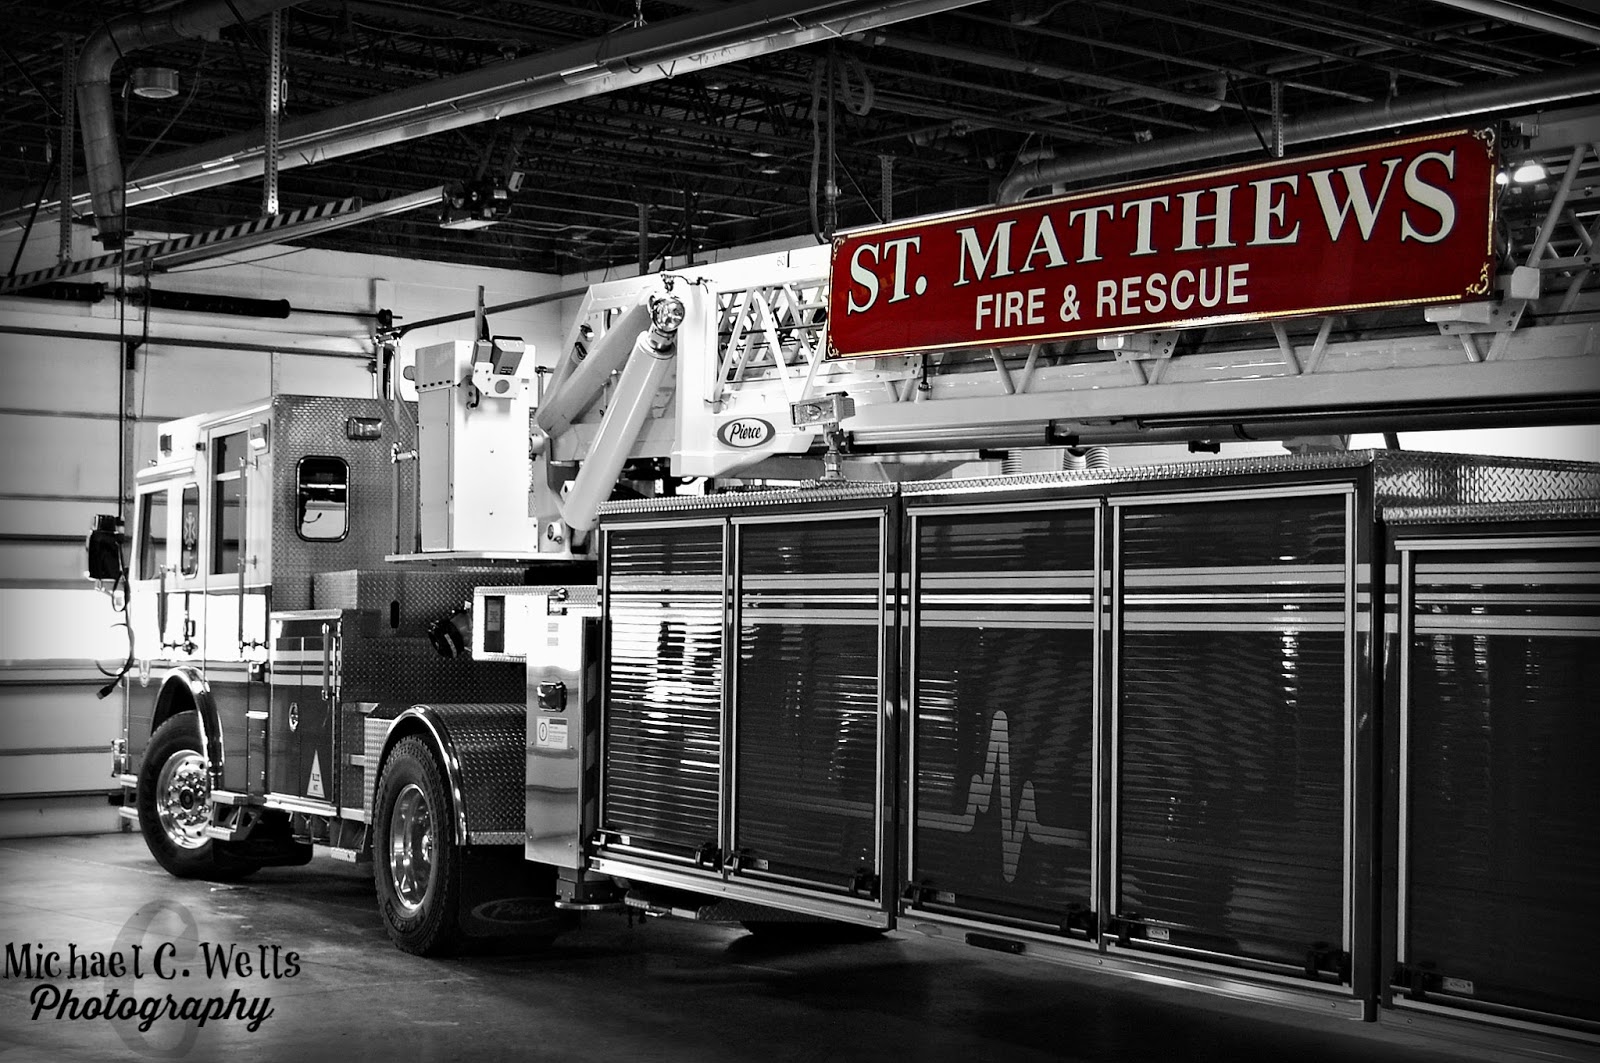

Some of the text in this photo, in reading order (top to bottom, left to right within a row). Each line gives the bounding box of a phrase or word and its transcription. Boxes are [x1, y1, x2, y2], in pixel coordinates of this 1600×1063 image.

[846, 149, 1456, 315] ST. MATTHEWS
[974, 262, 1251, 331] FIRE & RESCUE
[729, 422, 762, 444] Pierce
